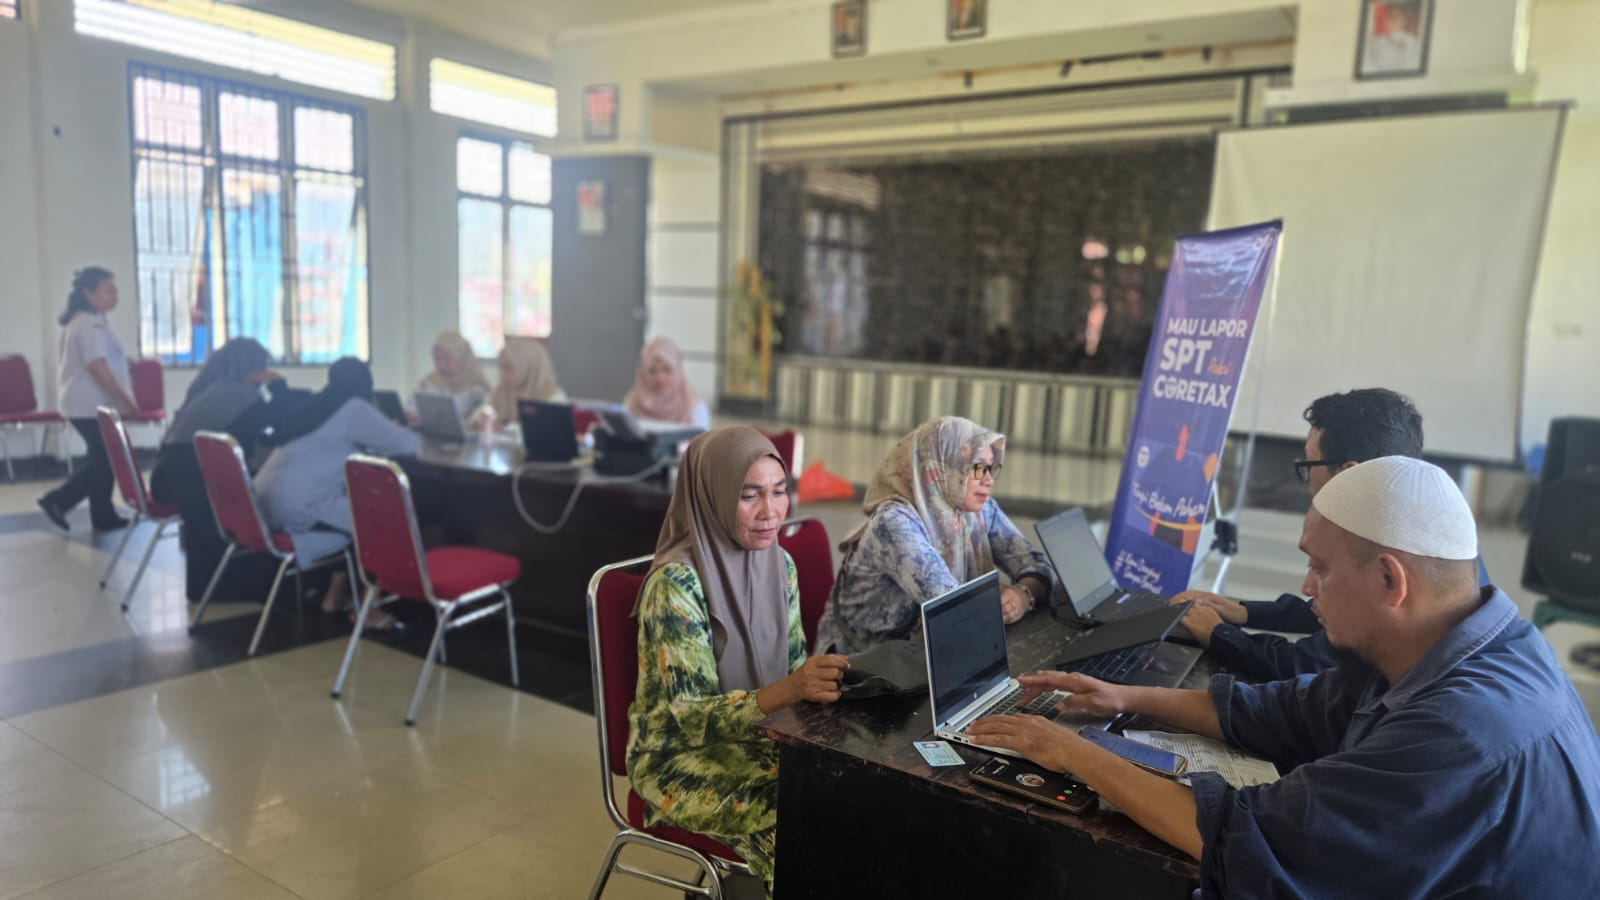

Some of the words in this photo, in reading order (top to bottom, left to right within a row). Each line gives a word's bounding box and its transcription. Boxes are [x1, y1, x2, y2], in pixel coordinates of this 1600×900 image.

[1167, 317, 1199, 336] MAU
[1199, 318, 1249, 338] LAPOR
[1160, 336, 1213, 375] SPT
[1153, 374, 1232, 408] CORETAX
